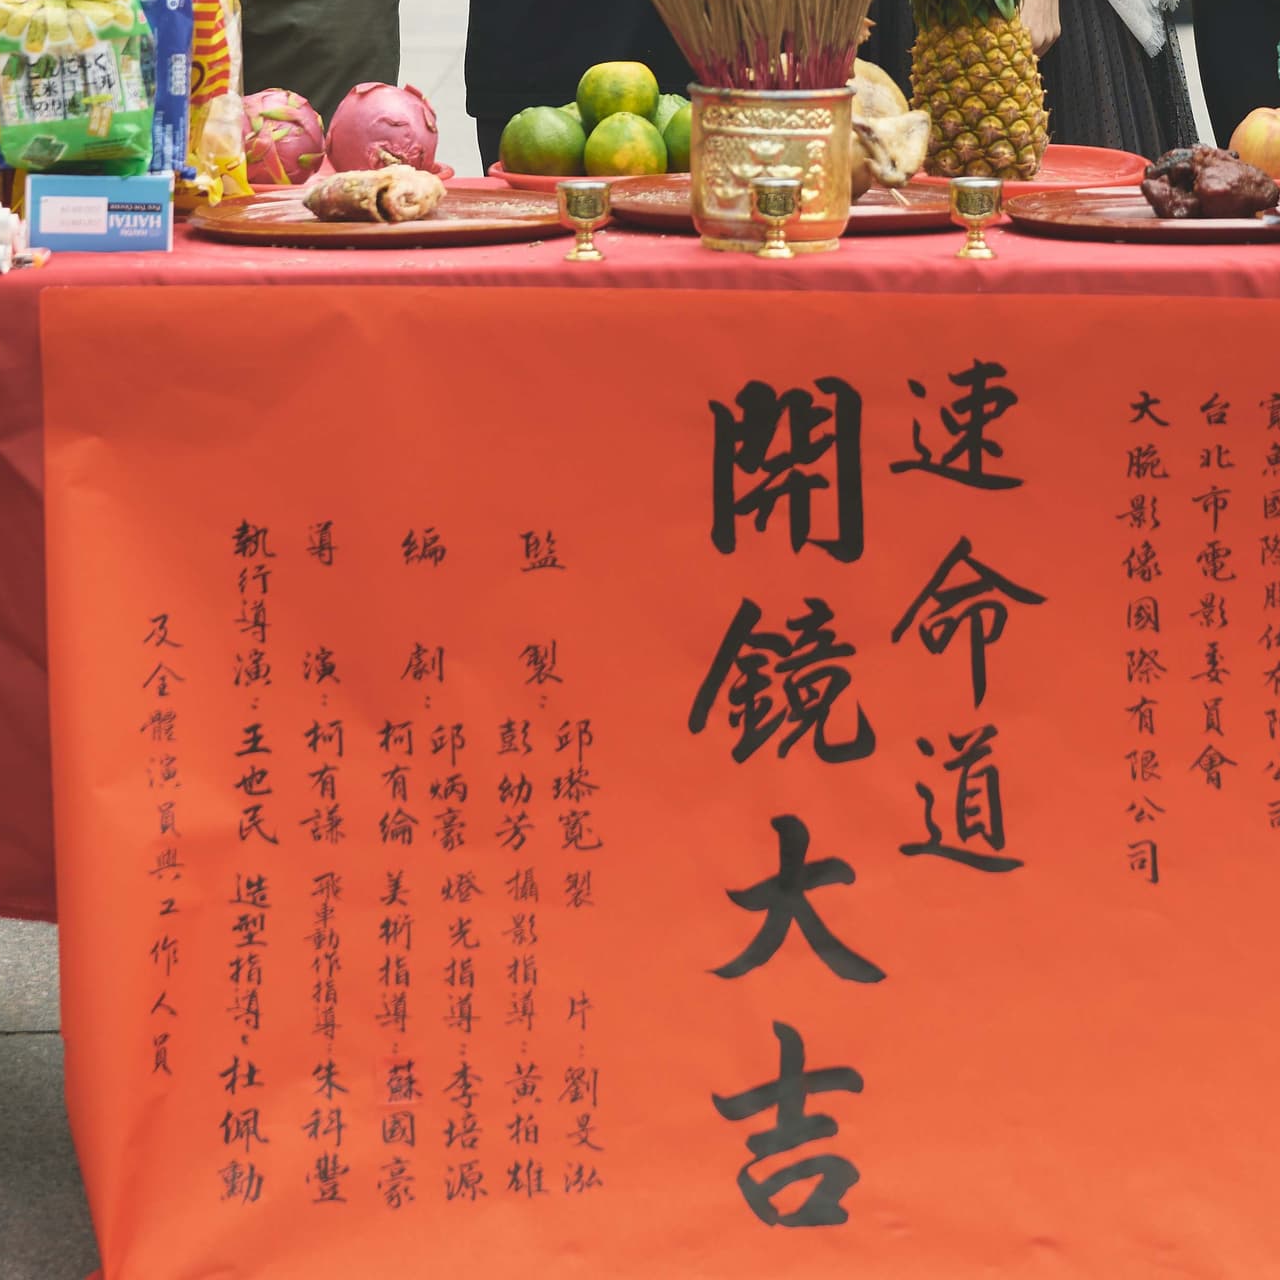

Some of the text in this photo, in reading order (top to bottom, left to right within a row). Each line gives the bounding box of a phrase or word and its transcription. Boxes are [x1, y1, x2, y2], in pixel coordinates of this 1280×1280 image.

[688, 375, 887, 1228] 開鏡大吉
[888, 358, 1048, 873] 速命道
[1116, 390, 1171, 885] 大腕影像國際有限公司
[1190, 391, 1238, 790] 台北市電影委員會
